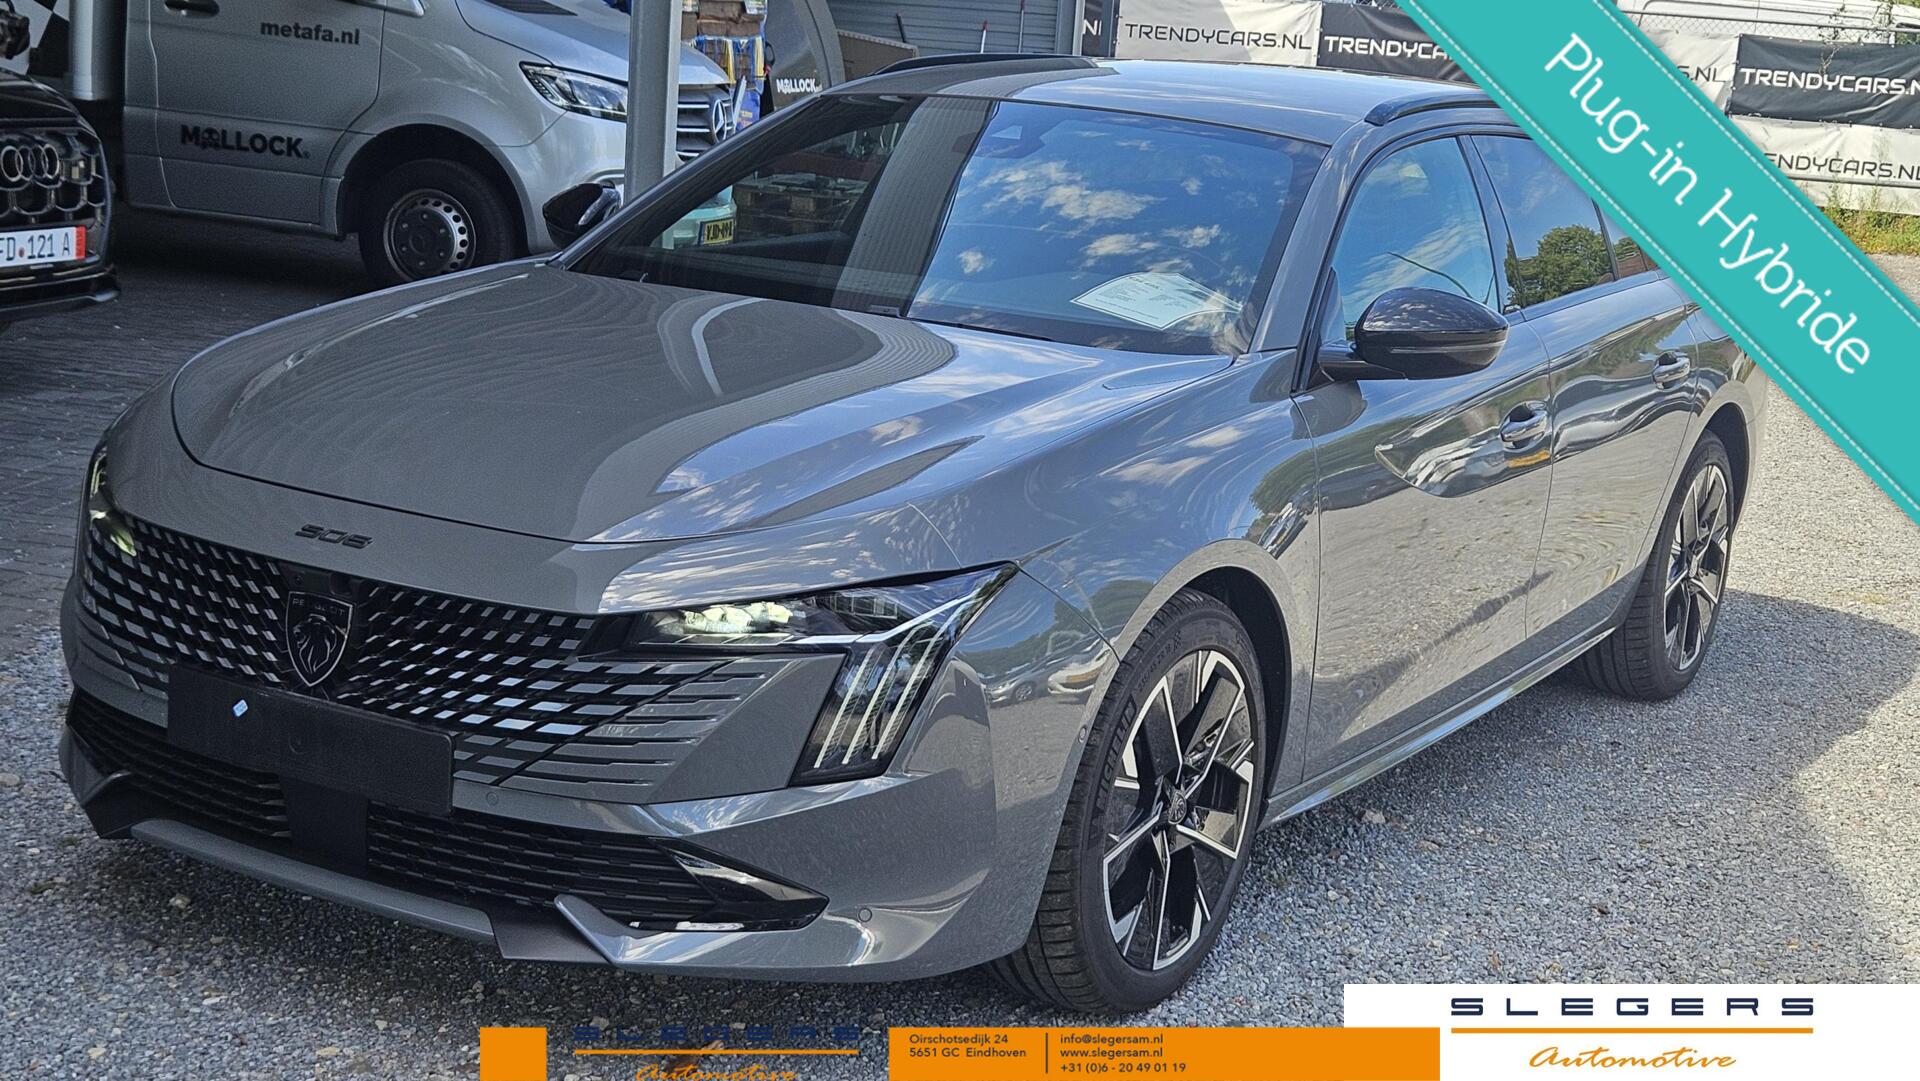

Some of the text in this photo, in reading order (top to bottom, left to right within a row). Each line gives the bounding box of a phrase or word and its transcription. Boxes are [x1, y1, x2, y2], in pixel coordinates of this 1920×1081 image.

[260, 22, 360, 45] metafa.nl
[1125, 23, 1312, 50] TRENDYCARS.NL
[1324, 36, 1453, 60] TRENDYCA
[27, 234, 55, 259] 121
[62, 232, 71, 256] A
